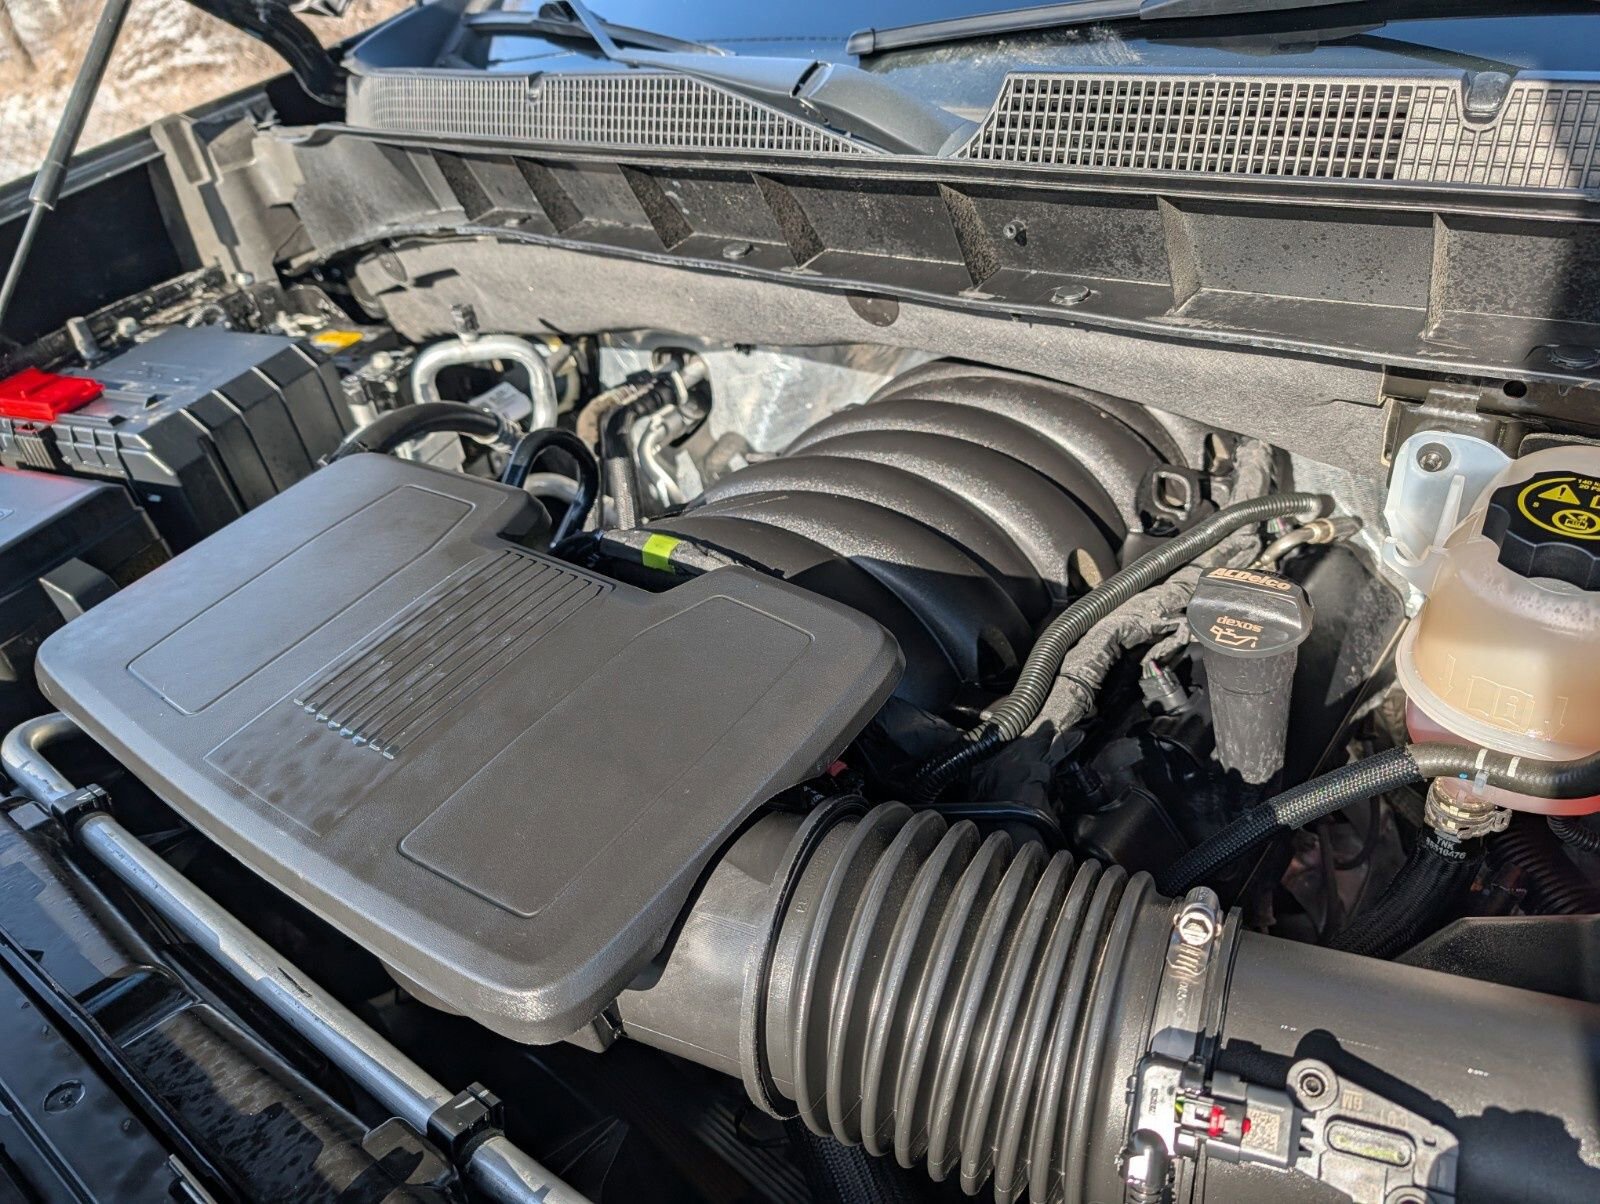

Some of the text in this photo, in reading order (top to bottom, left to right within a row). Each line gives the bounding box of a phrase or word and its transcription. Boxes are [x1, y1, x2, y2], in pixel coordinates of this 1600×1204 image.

[1207, 567, 1292, 591] ACDelco
[1216, 615, 1264, 633] dexos
[1436, 837, 1455, 851] TNK
